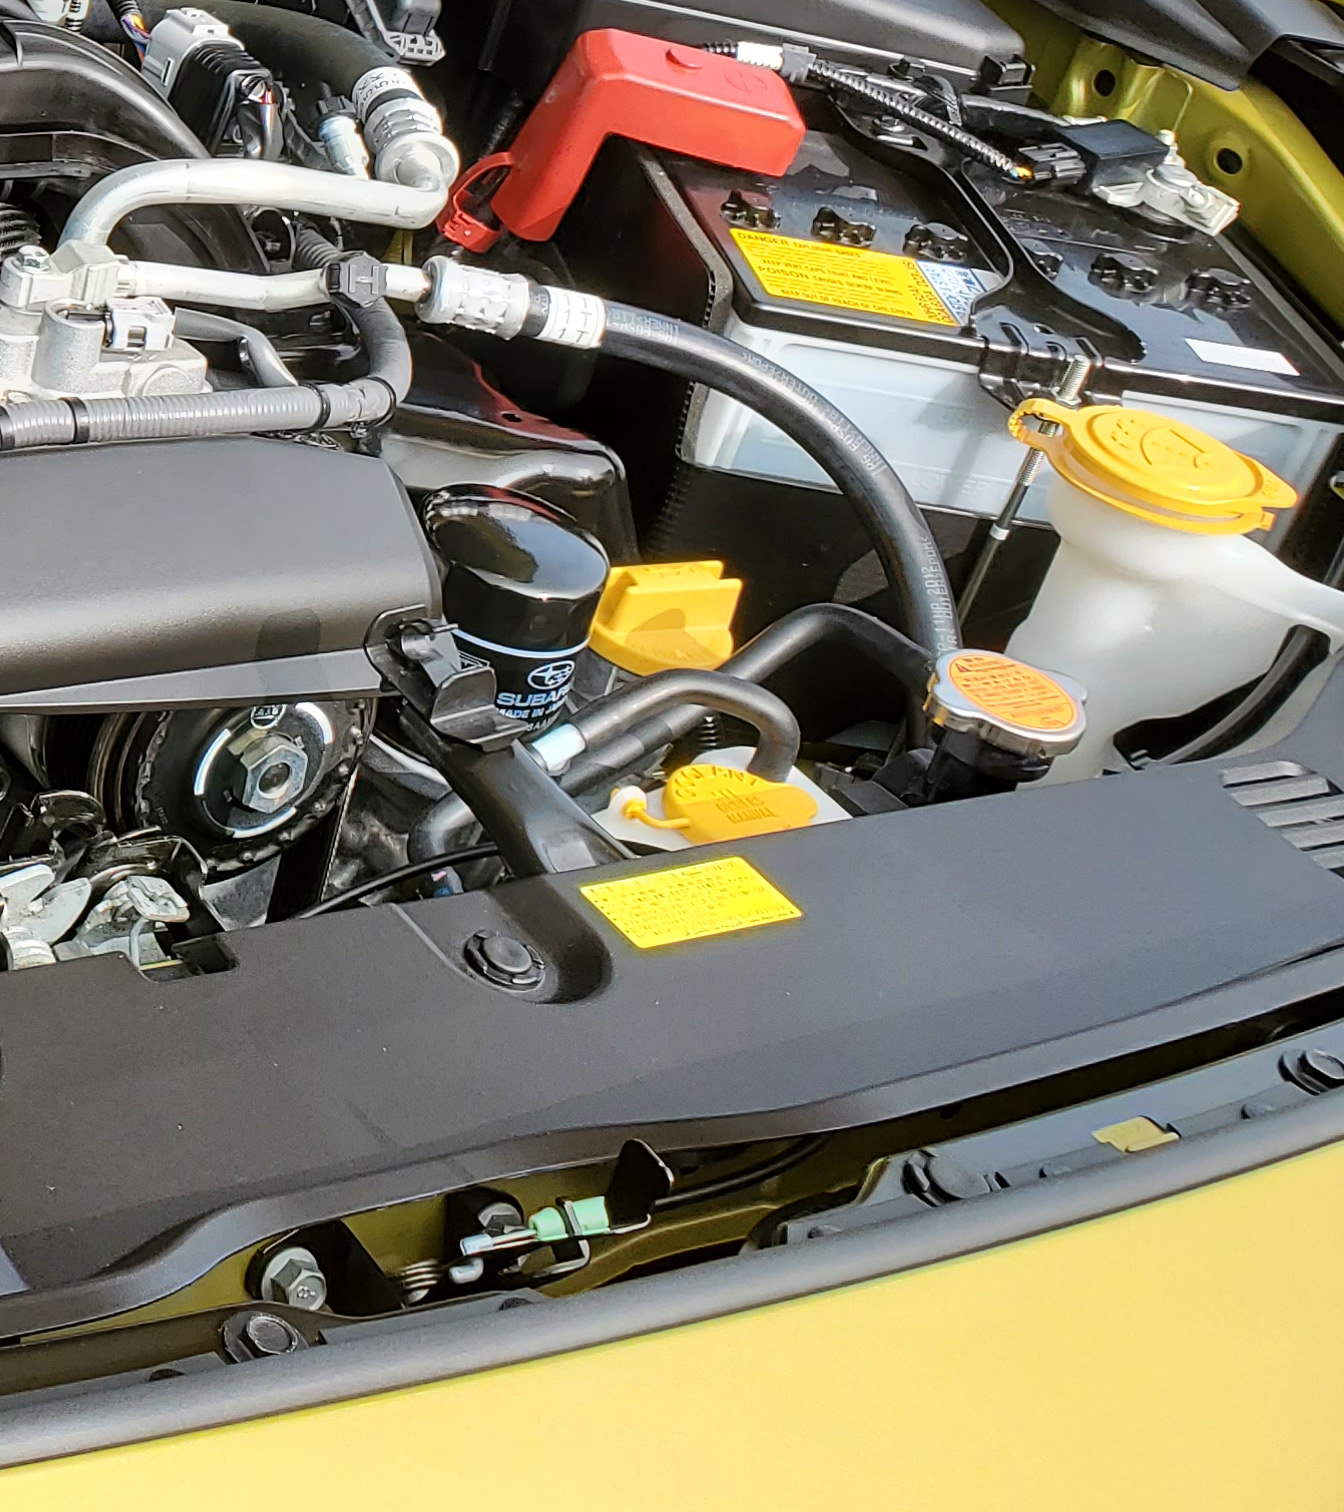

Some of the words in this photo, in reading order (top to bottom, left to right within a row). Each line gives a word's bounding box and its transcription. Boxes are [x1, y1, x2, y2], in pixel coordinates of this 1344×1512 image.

[738, 232, 790, 246] DANGER
[349, 264, 379, 294] H
[758, 266, 809, 280] POISON
[496, 683, 571, 707] SUBAR
